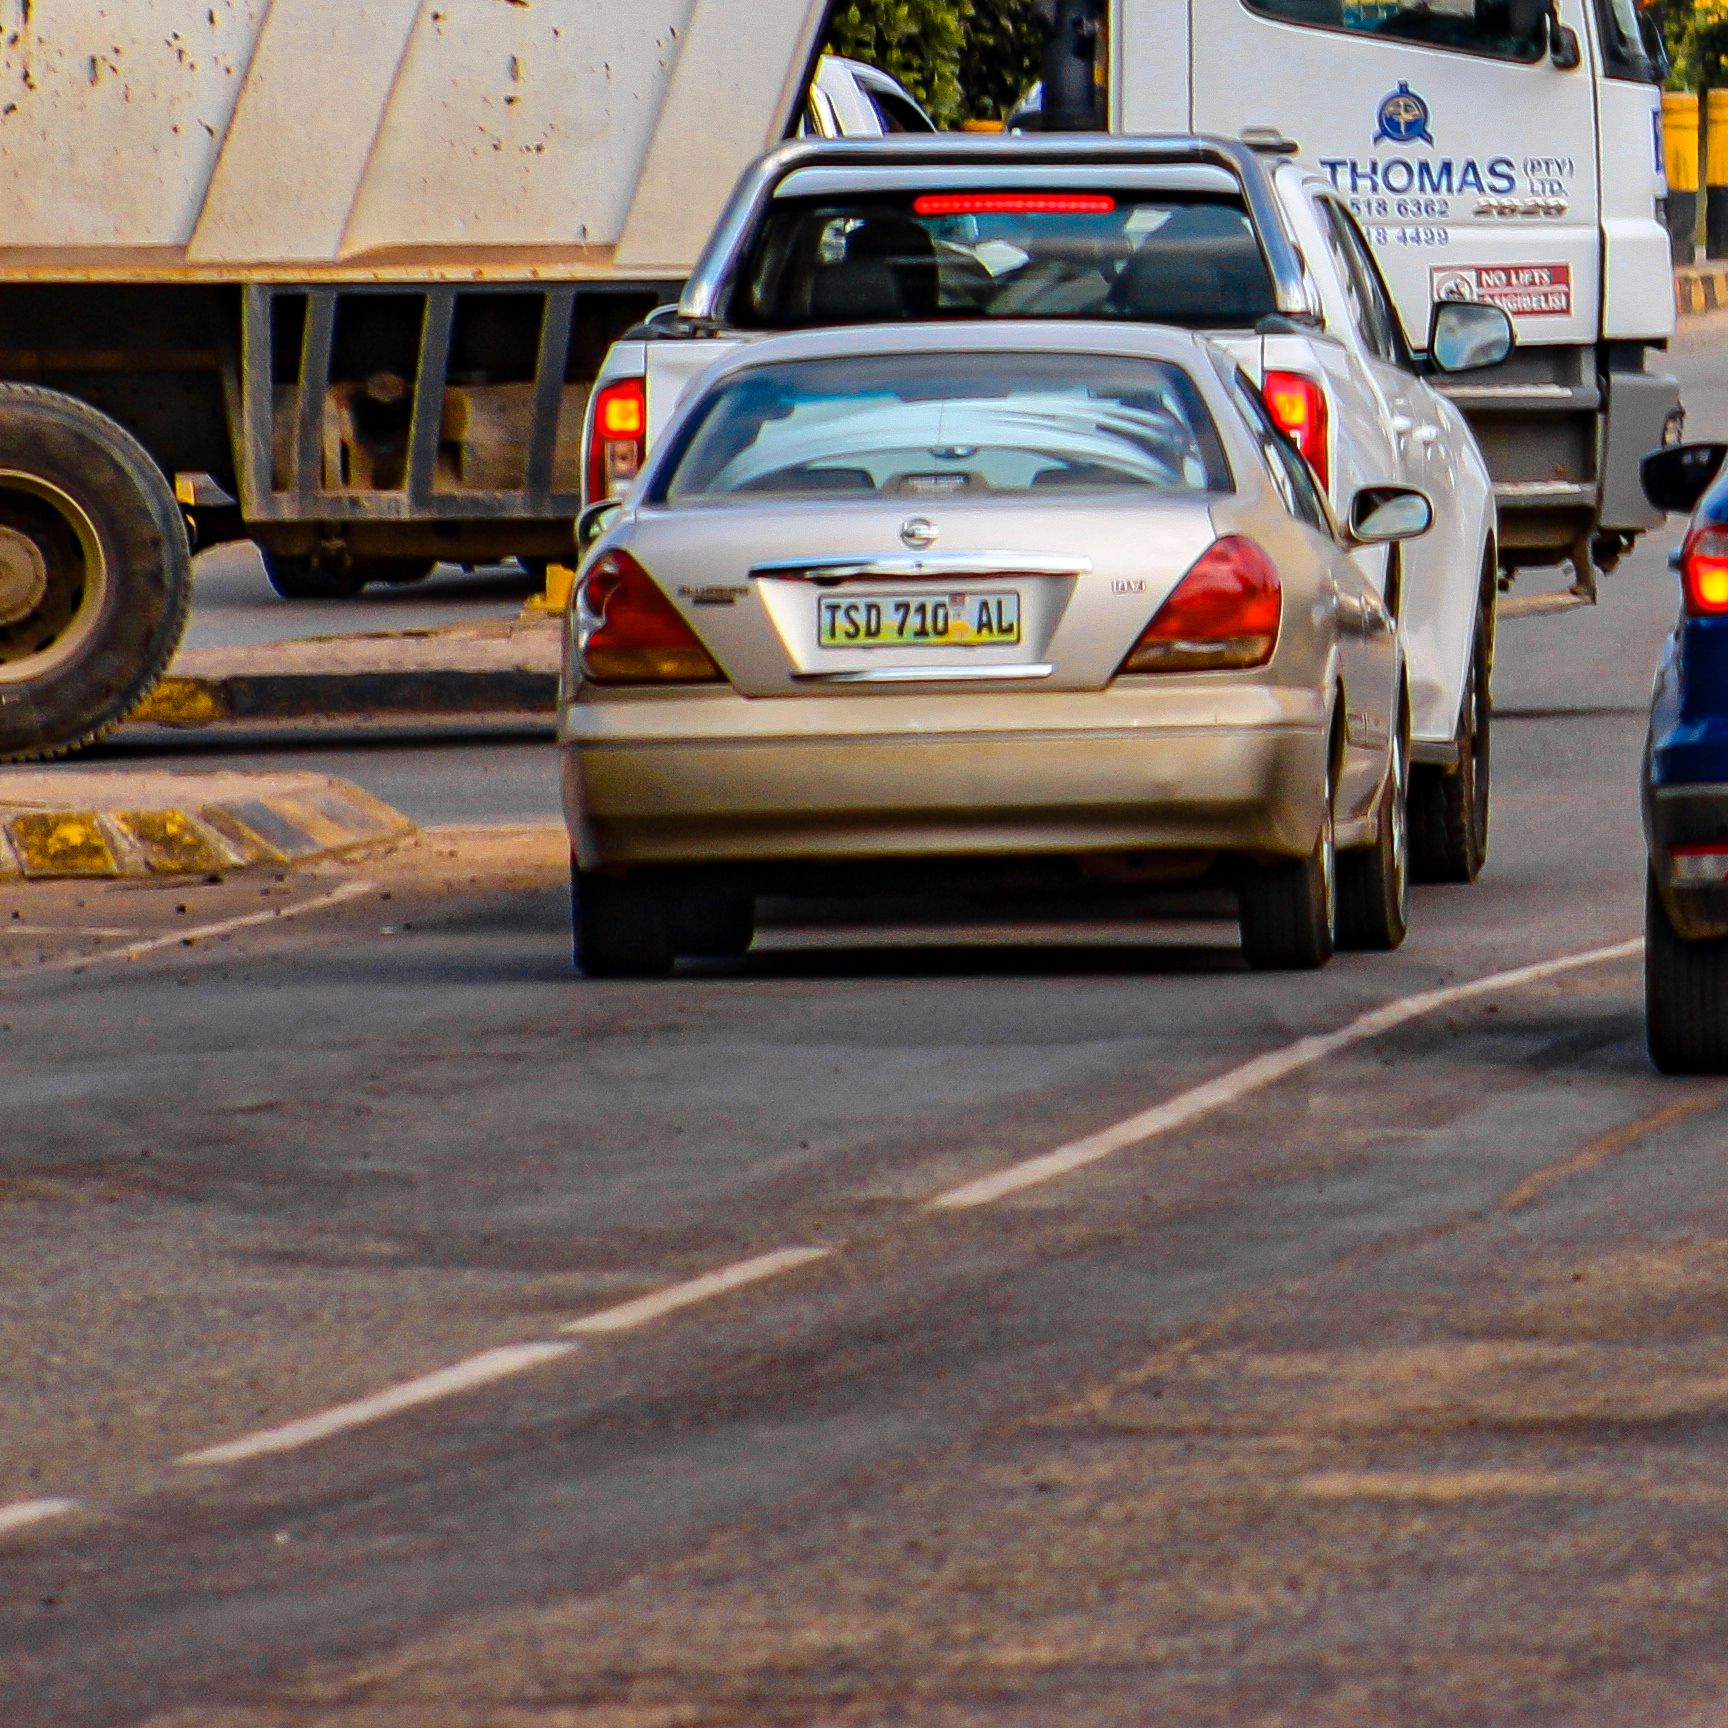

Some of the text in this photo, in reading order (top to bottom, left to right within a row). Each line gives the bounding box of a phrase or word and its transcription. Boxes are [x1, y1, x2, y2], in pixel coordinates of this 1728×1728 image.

[1318, 157, 1516, 195] THOMAS
[1522, 156, 1575, 178] (PTY)
[1396, 198, 1450, 219] 6362
[1396, 226, 1450, 247] 4499
[1481, 268, 1553, 288] NO LIFTS
[825, 599, 1015, 639] TSD 710 AL
